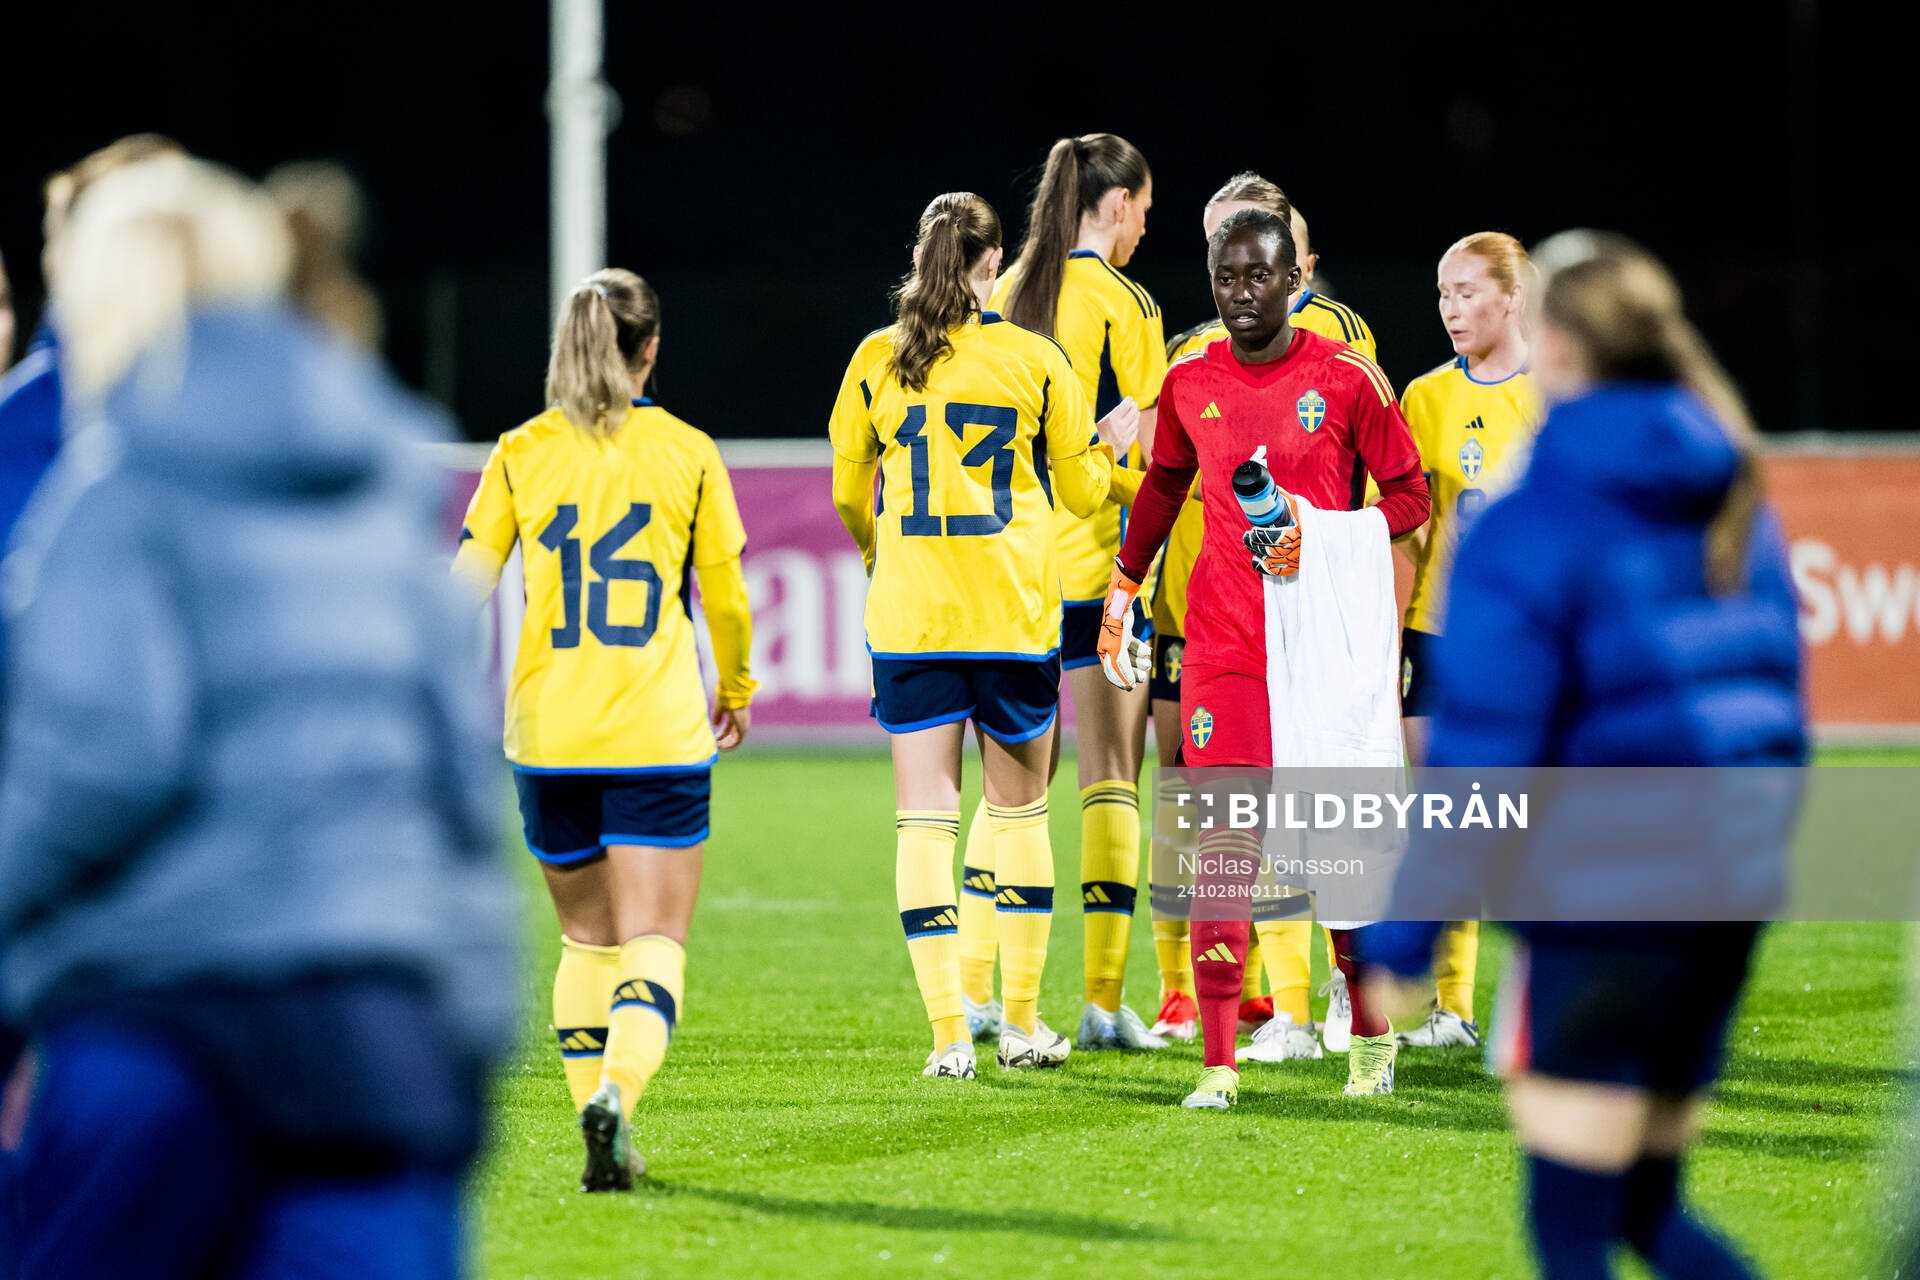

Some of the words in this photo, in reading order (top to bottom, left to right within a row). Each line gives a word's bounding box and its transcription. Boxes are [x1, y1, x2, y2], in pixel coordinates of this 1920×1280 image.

[895, 402, 1018, 537] 13
[538, 502, 663, 649] 16
[1790, 540, 1920, 646] Sw
